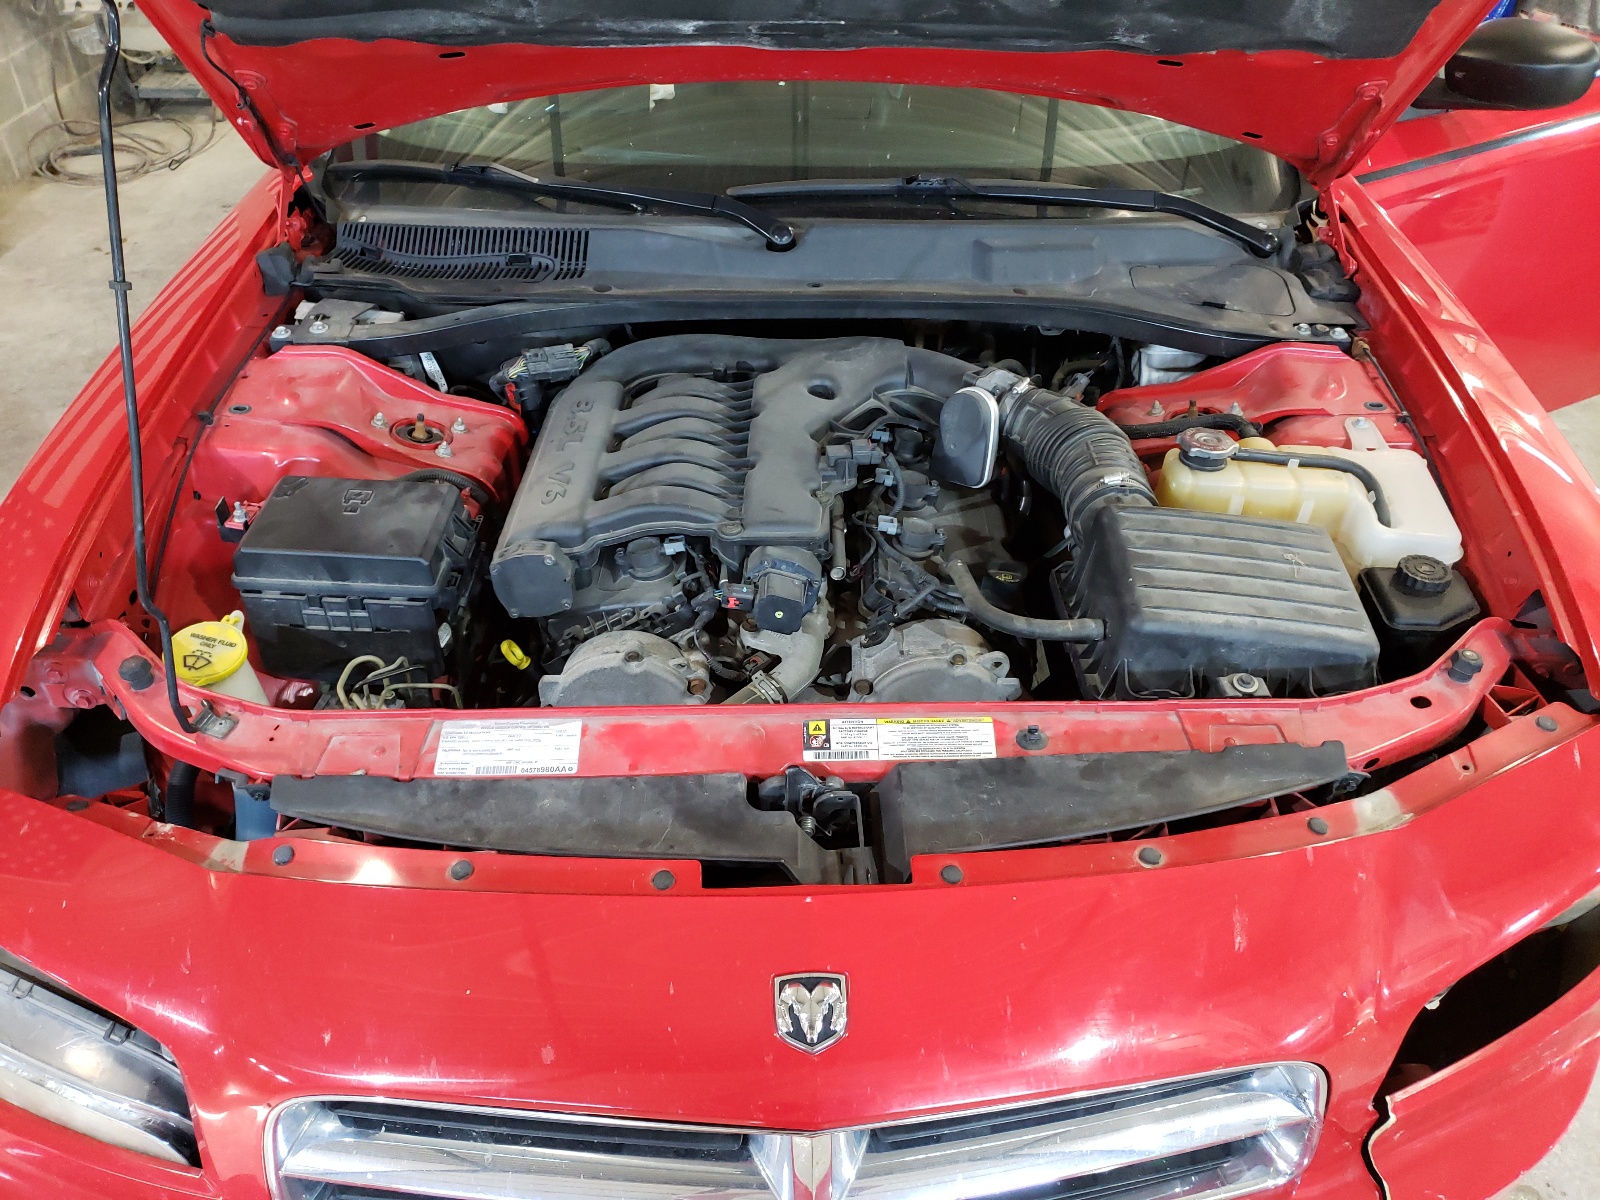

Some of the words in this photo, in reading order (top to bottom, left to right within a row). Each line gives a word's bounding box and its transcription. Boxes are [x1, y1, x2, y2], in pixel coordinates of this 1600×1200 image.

[540, 462, 575, 505] V6
[190, 632, 217, 643] WASHER
[217, 639, 237, 647] FLUID
[199, 641, 216, 649] ONLY
